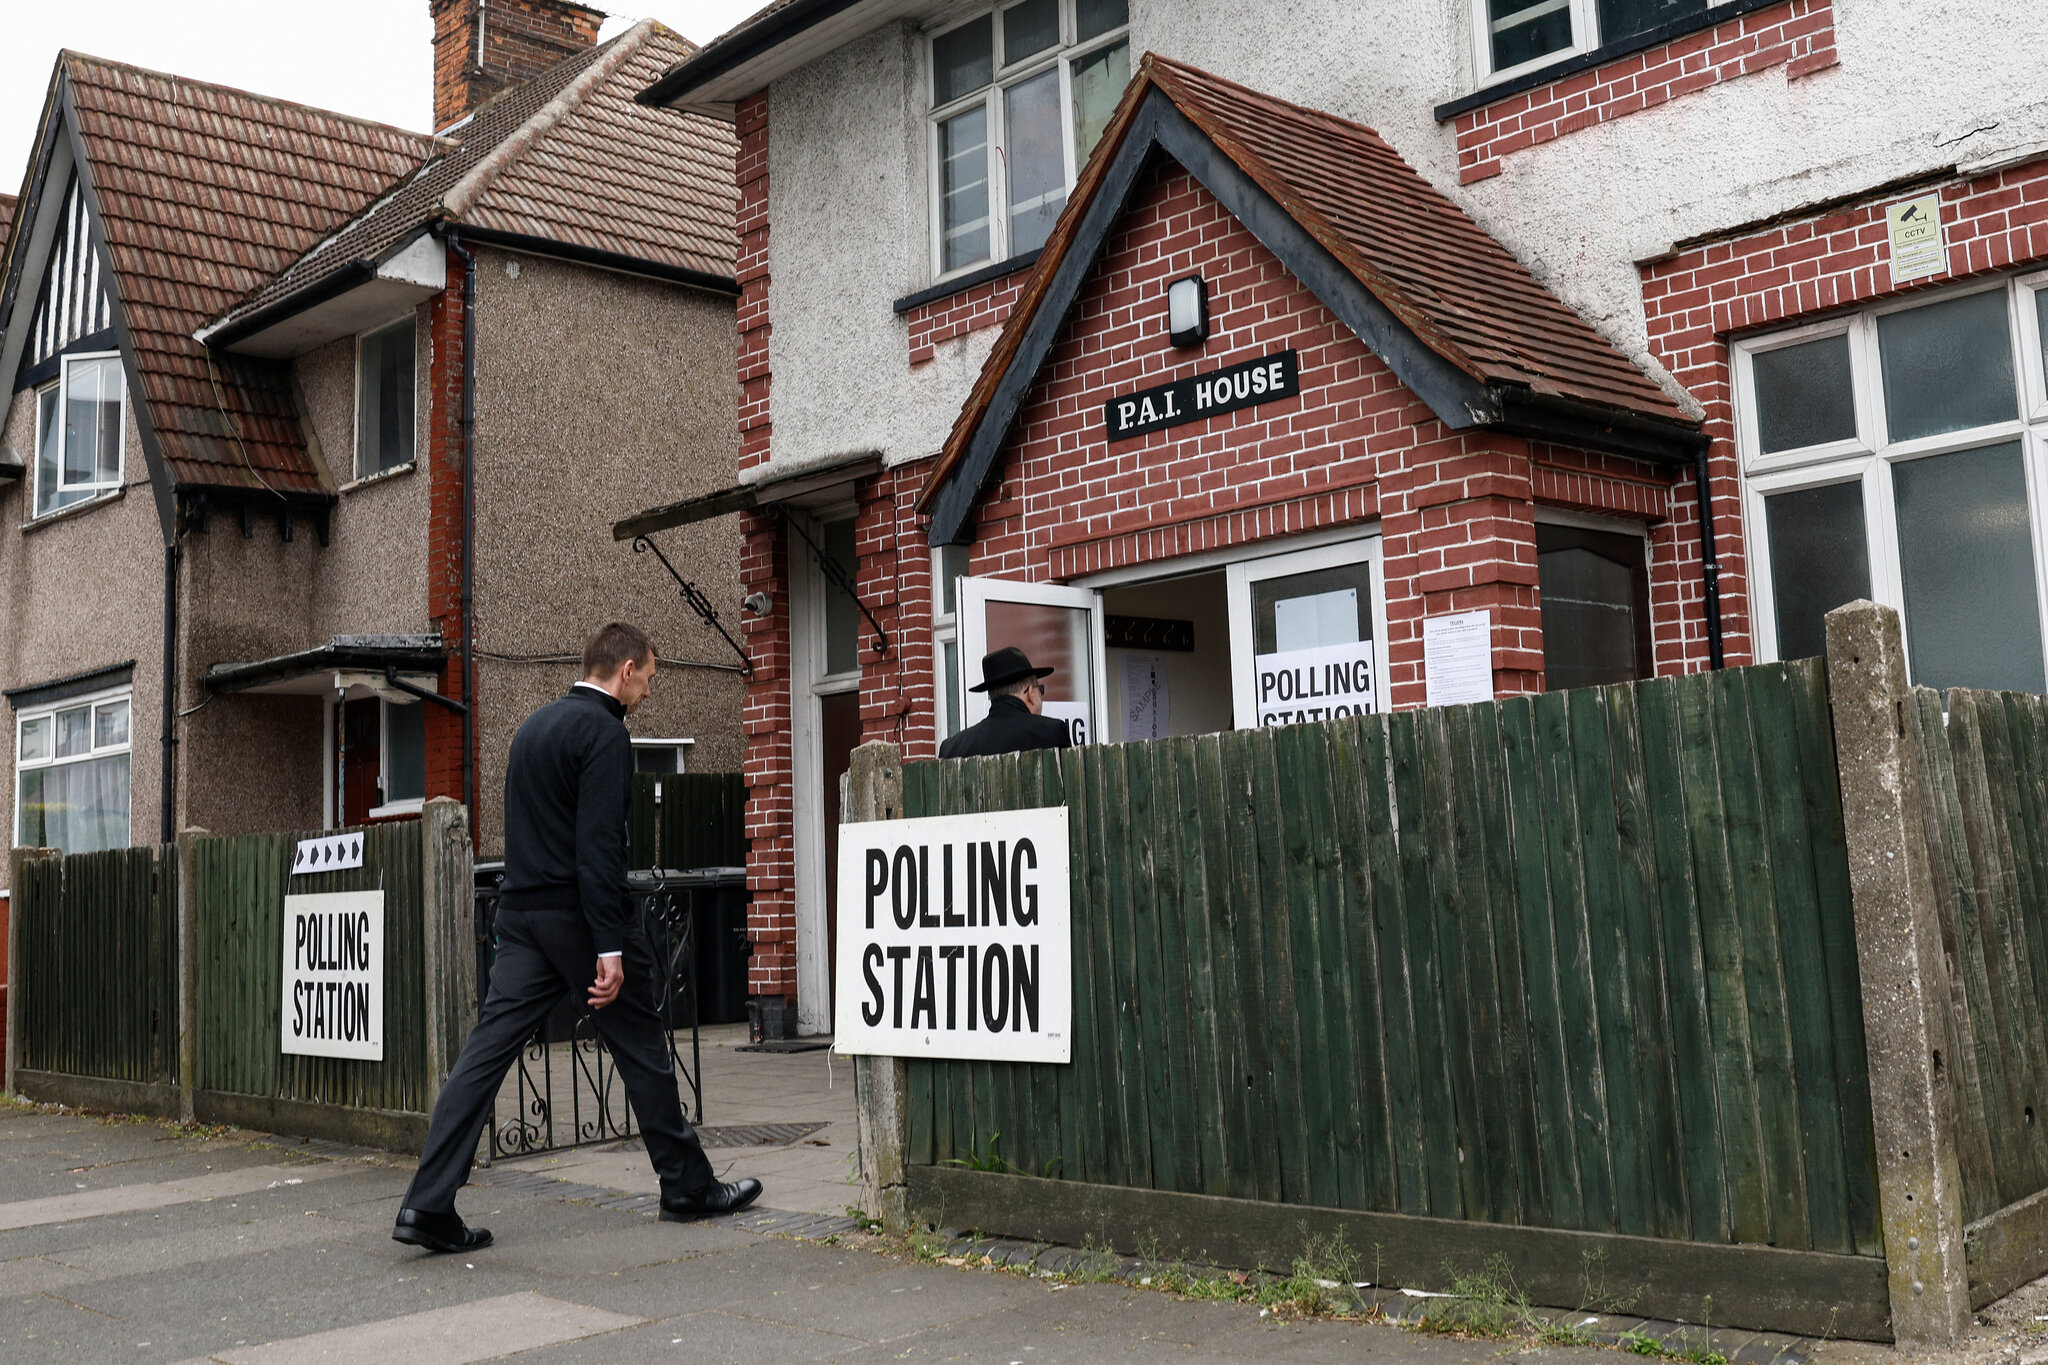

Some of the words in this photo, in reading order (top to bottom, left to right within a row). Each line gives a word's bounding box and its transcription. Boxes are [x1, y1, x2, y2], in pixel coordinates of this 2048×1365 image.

[1904, 227, 1926, 239] CCTV
[1117, 390, 1182, 431] P.A.I.
[1196, 362, 1285, 410] HOUSE
[1129, 680, 1161, 722] SAMPLE
[1261, 660, 1370, 703] POLLING
[865, 837, 1039, 930] POLLING
[295, 911, 370, 972] POLLING
[293, 978, 369, 1042] STATION
[861, 942, 1039, 1033] STATION
